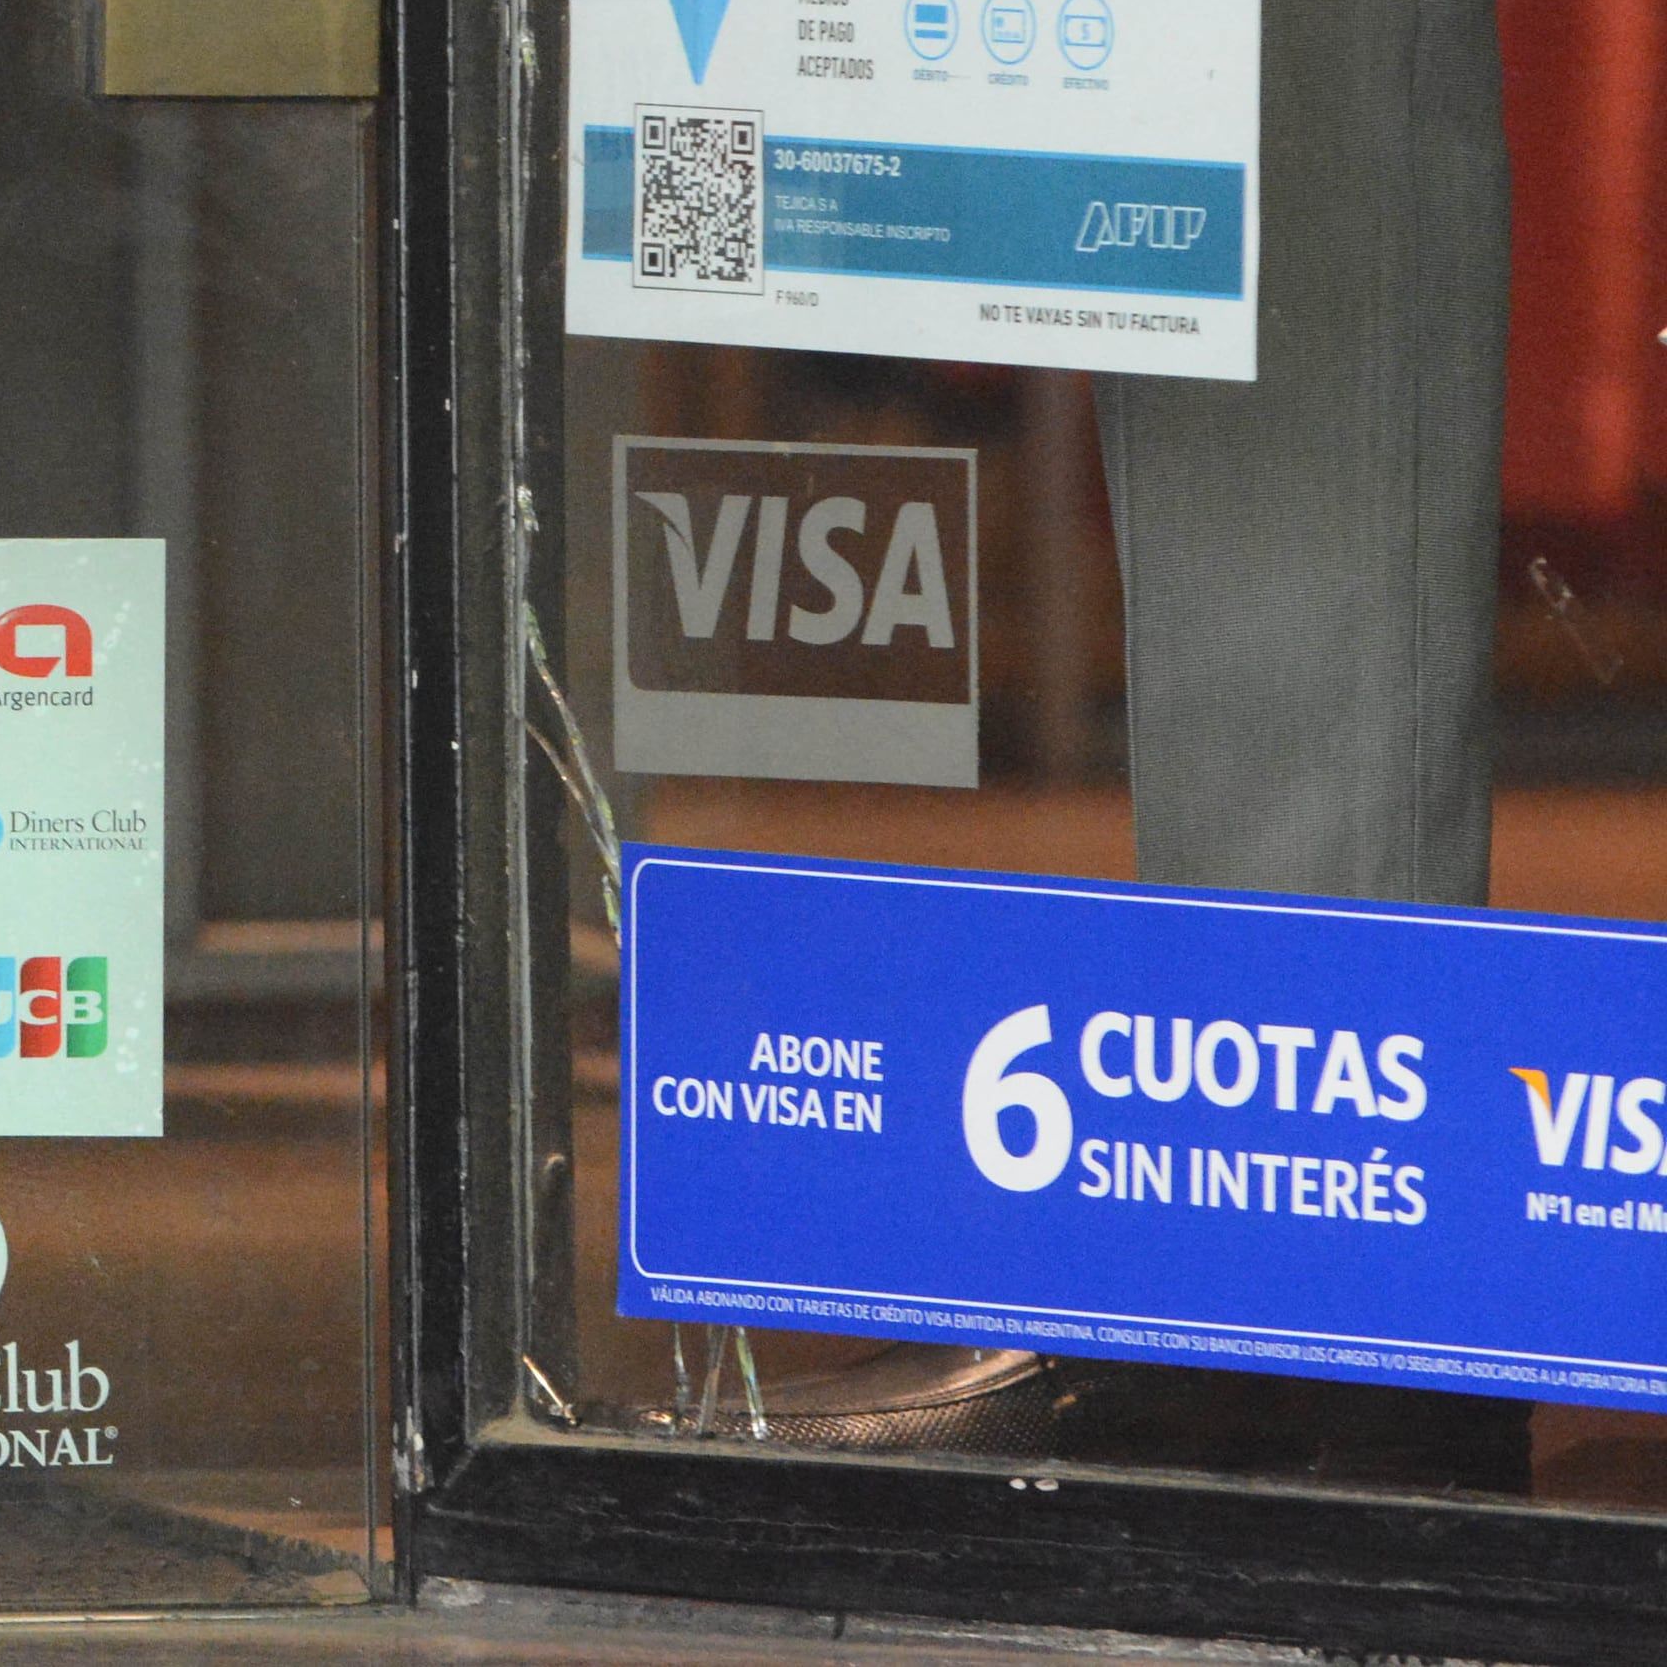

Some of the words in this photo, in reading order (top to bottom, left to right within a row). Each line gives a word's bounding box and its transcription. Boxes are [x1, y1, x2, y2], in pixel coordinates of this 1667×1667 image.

[798, 19, 817, 41] DE
[819, 21, 855, 43] PAGO
[797, 56, 874, 80] ACEPTADOS
[774, 149, 902, 177] 30-60037675-2
[796, 219, 884, 238] RESPONSABLE
[886, 225, 951, 243] INSCRIPTO
[1075, 201, 1207, 252] AFIP
[980, 304, 1000, 322] NO
[1004, 305, 1022, 323] TE
[1025, 307, 1073, 326] VAYAS
[1077, 310, 1102, 328] SIN
[1107, 312, 1126, 330] TU
[1131, 313, 1200, 334] FACTURA
[633, 490, 956, 649] VISA
[9, 838, 147, 851] INTERNATIONAL
[10, 809, 85, 833] Diners
[92, 809, 147, 833] Club
[750, 1031, 884, 1082] ABONE
[1079, 1010, 1428, 1121] CUOTAS
[652, 1076, 733, 1121] CON
[740, 1083, 827, 1129] VISA
[833, 1089, 883, 1134] EN
[961, 1003, 1074, 1193] 6
[1508, 1067, 1667, 1177] VIS
[1078, 1138, 1173, 1205] SIN
[1189, 1146, 1428, 1226] INTERÉS
[1575, 1203, 1607, 1228] en
[1610, 1199, 1634, 1231] el
[651, 1284, 694, 1305] VÁLIDA
[696, 1290, 766, 1311] ABONANDO
[767, 1295, 794, 1313] CON
[796, 1297, 853, 1318] TARJETAS
[854, 1304, 870, 1320] DE
[871, 1304, 924, 1325] CRÉDITO
[924, 1311, 954, 1327] VISA
[954, 1313, 1005, 1333] EMITIDA
[1006, 1319, 1022, 1334] EN
[1097, 1326, 1160, 1347] CONSULTE
[1161, 1332, 1190, 1350] CON
[1192, 1334, 1209, 1352] SU
[1210, 1336, 1252, 1355] BANCO
[1253, 1340, 1300, 1360] EMISOR
[1302, 1344, 1326, 1363] LOS
[1327, 1347, 1378, 1367] CARGOS
[1379, 1352, 1405, 1370] Y/O
[1406, 1354, 1464, 1375] SEGUROS
[1466, 1361, 1538, 1383] ASOCIADOS
[1539, 1368, 1550, 1383] A
[1552, 1369, 1567, 1385] LA
